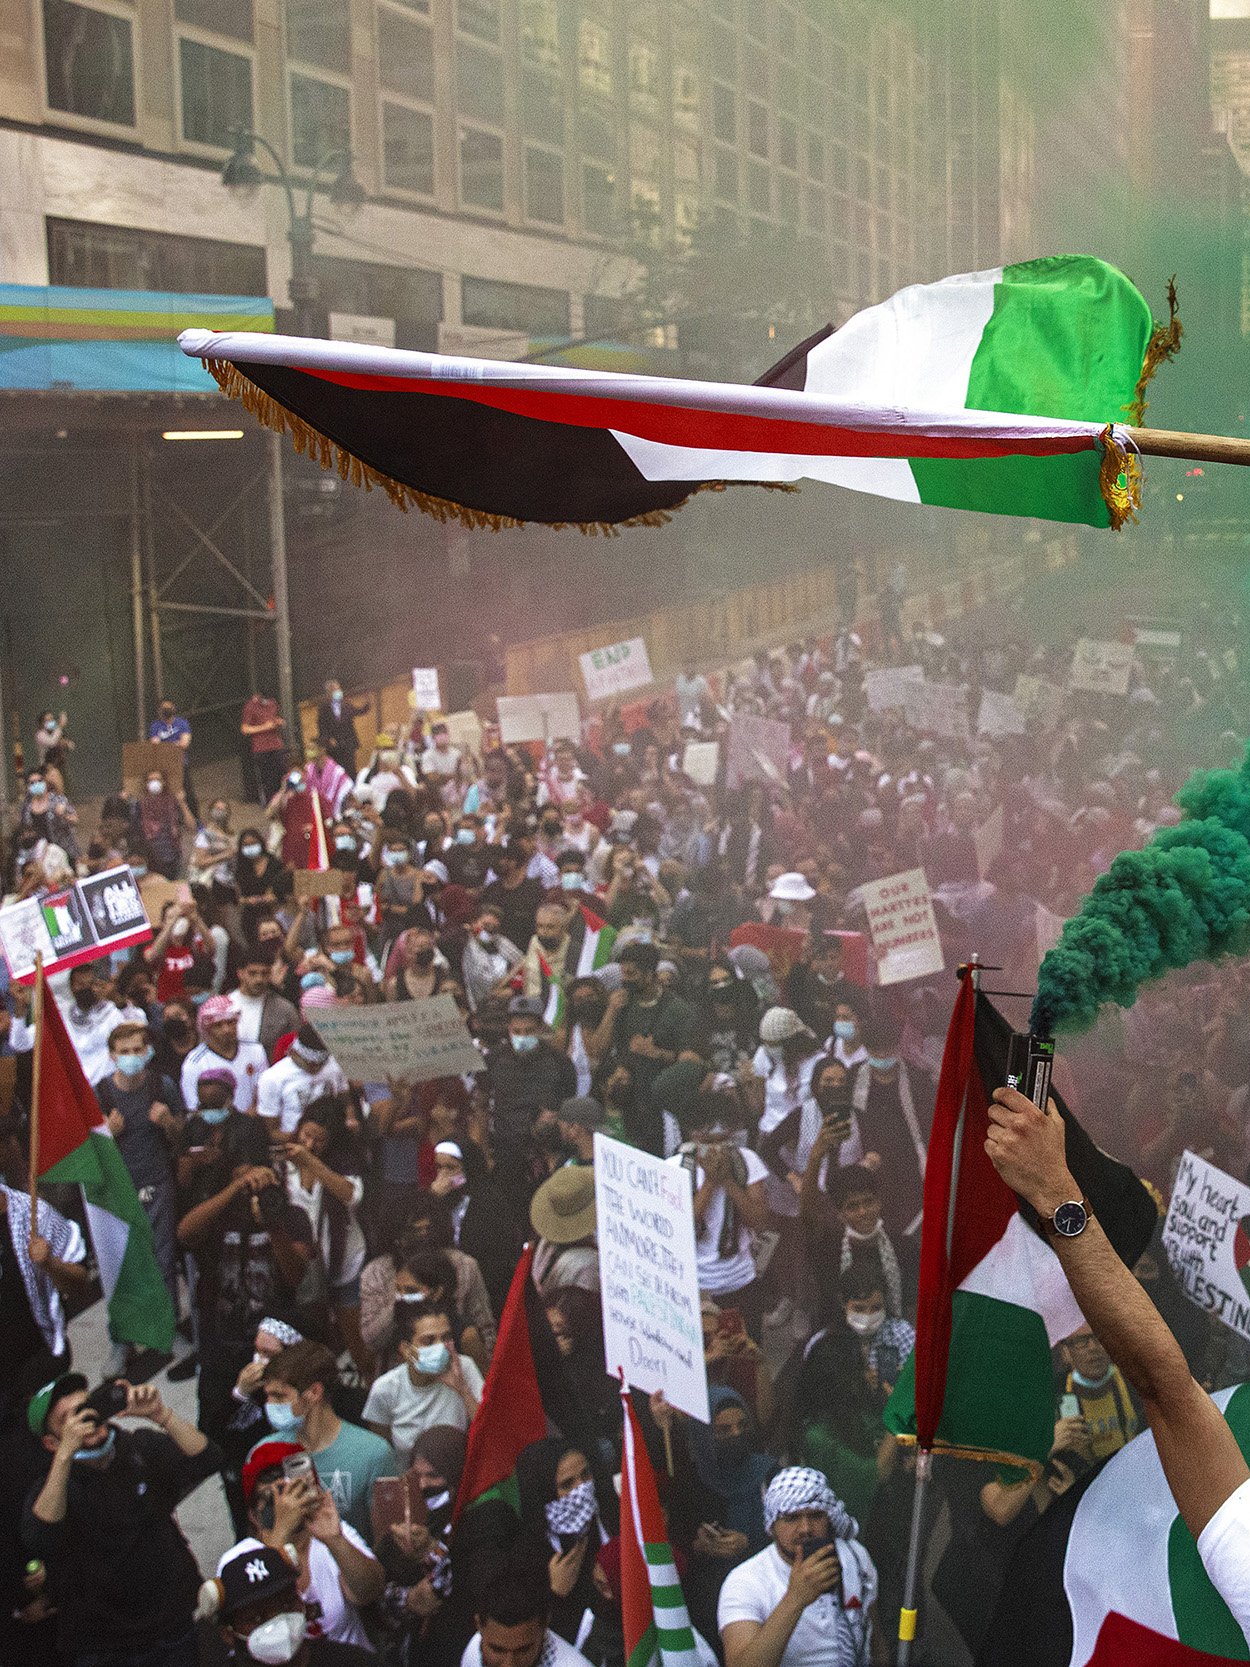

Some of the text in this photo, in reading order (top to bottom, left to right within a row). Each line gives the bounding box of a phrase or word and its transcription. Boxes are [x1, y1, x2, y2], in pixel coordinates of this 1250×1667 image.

[879, 882, 909, 899] OUR
[872, 911, 928, 934] ARE NOT
[600, 1147, 623, 1181] YOU
[1178, 1158, 1199, 1196] My
[602, 1183, 624, 1216] THE
[1199, 1214, 1229, 1243] and
